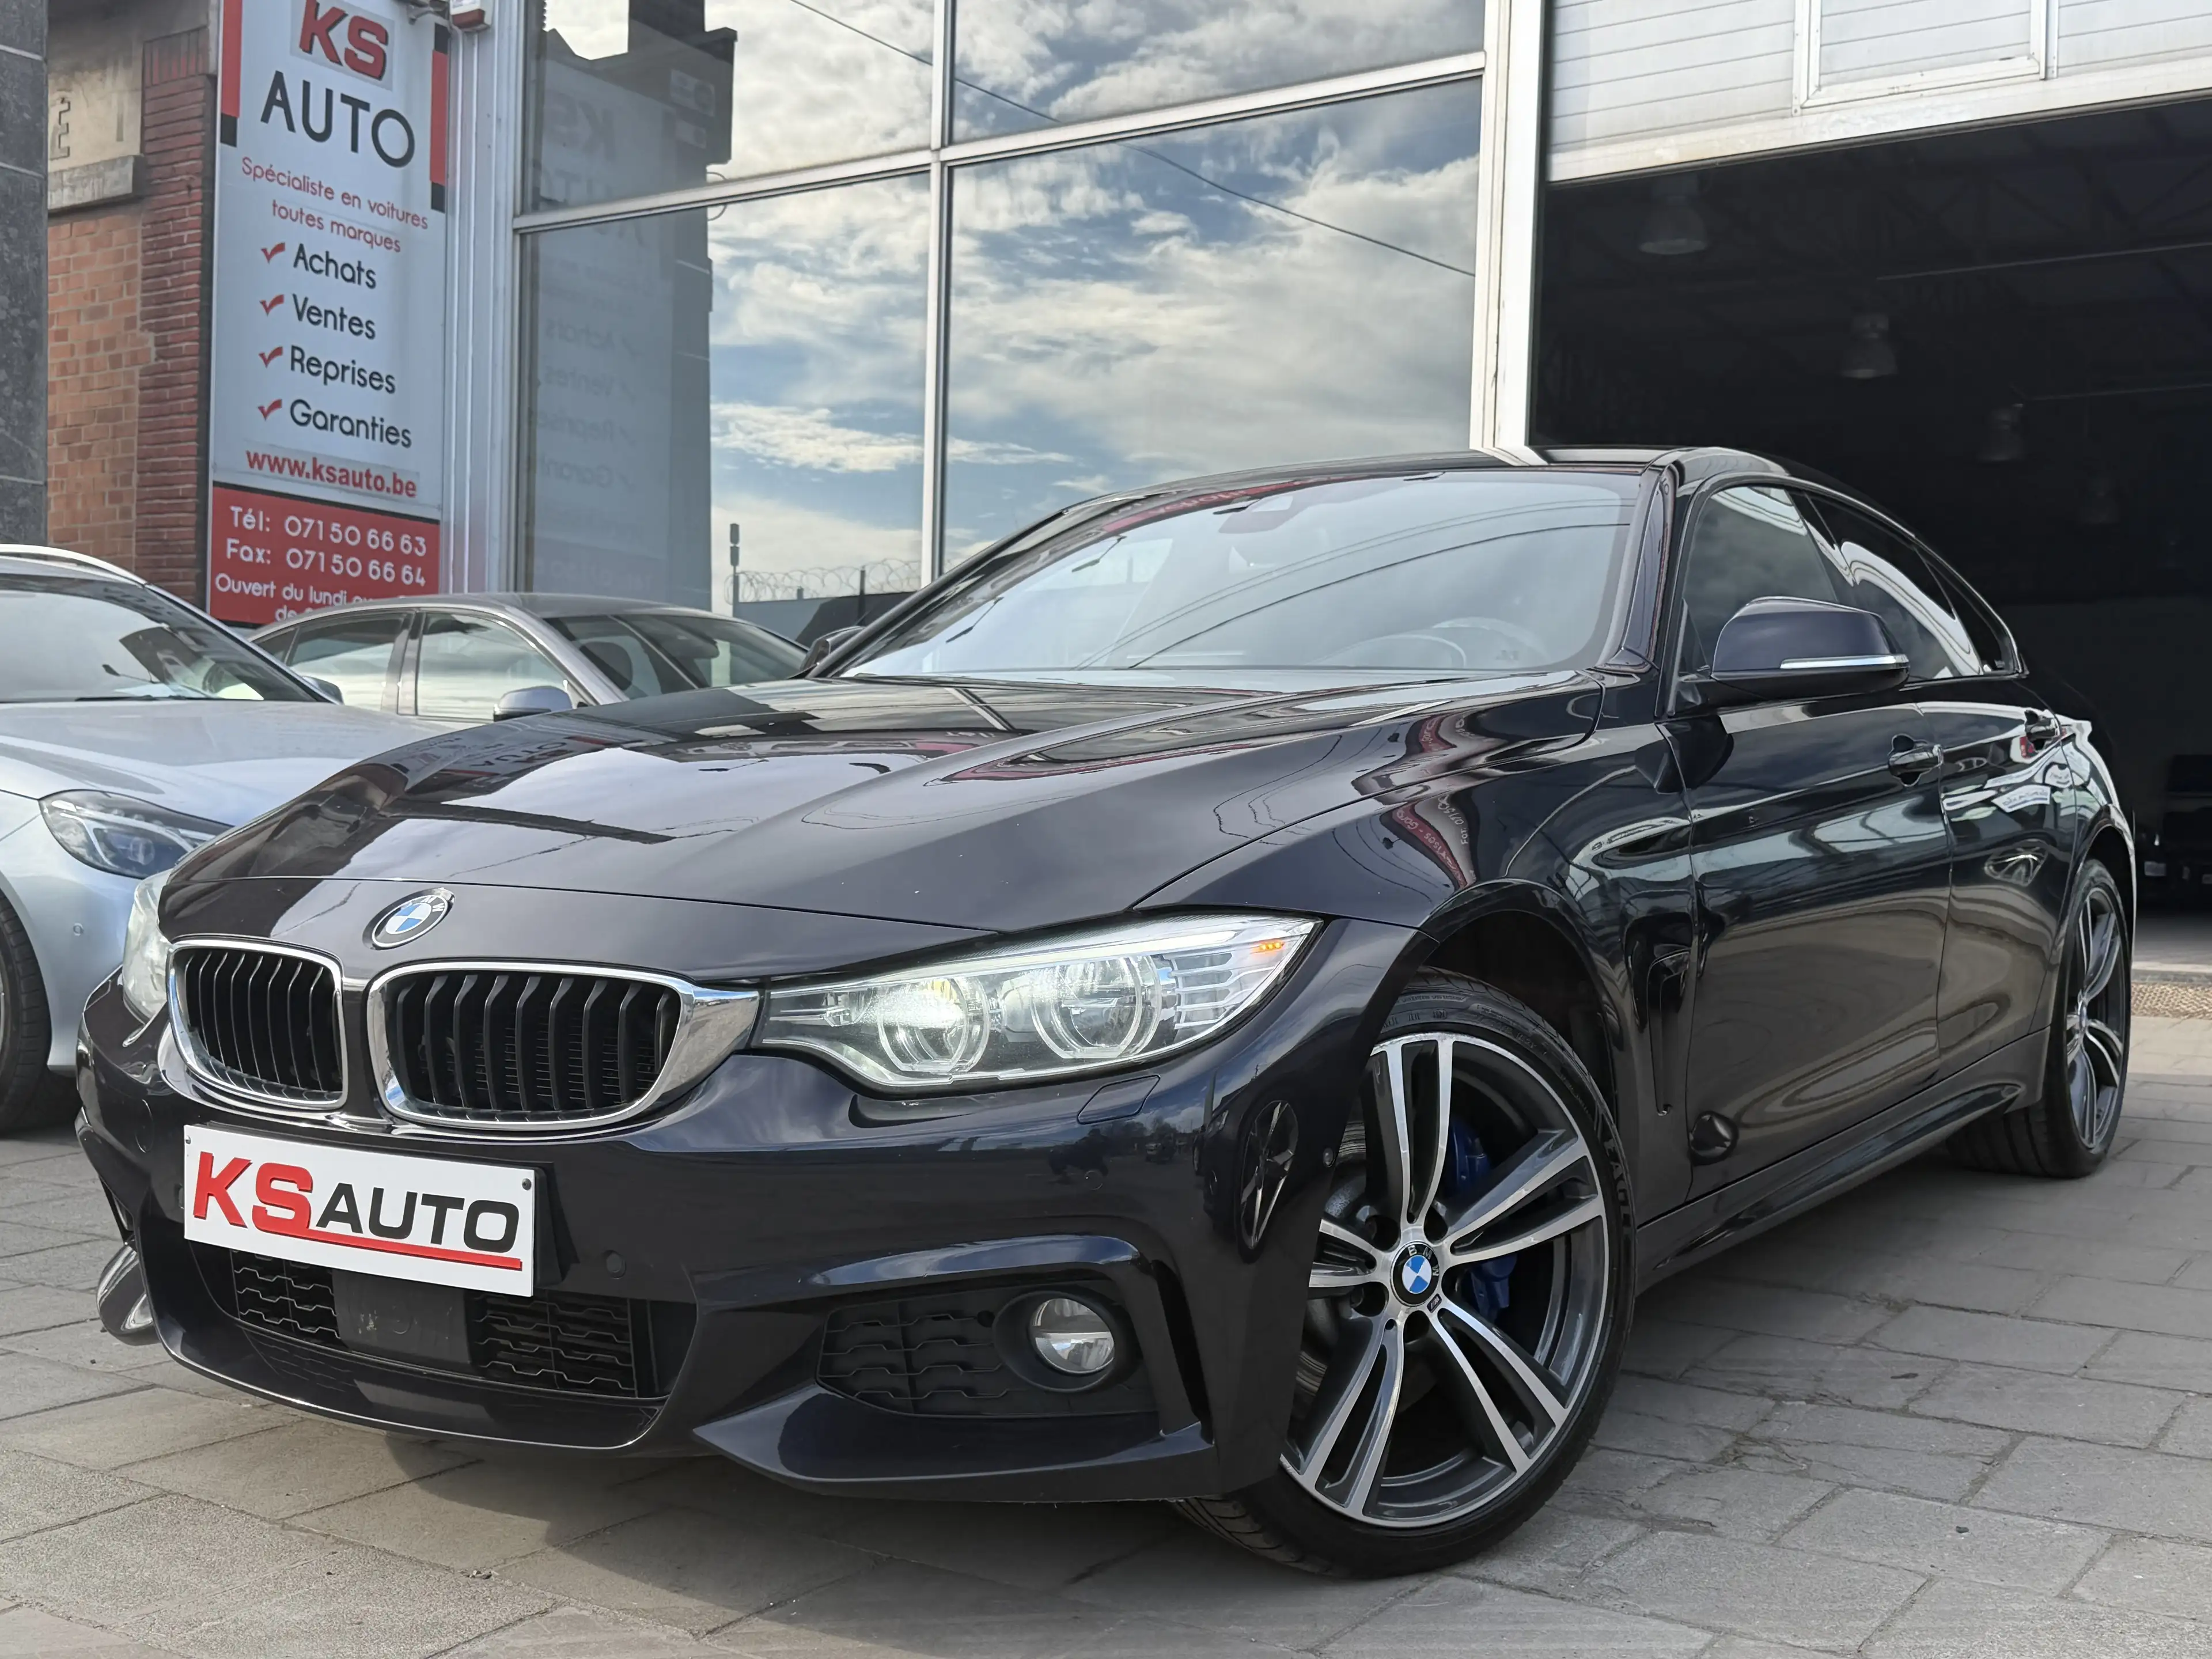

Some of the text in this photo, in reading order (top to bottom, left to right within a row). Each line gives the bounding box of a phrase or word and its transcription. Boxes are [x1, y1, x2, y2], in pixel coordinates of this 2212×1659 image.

[300, 0, 389, 81] KS
[260, 70, 415, 168] AUTO
[242, 156, 428, 230] Spécialiste en voitures
[272, 199, 401, 252] toutes marques
[293, 243, 376, 289] Achats
[292, 293, 376, 340] Ventes
[290, 344, 396, 394] Reprises
[290, 399, 412, 449] Garanties
[245, 450, 416, 498] www.ksauto.be
[230, 506, 270, 532] Tél:
[367, 528, 395, 551] 66
[400, 534, 426, 556] 63
[226, 539, 271, 564] Fax:
[368, 560, 395, 582] 66
[402, 565, 426, 586] 64
[215, 573, 276, 598] Ouvert
[282, 584, 303, 601] du
[310, 586, 347, 605] lundi
